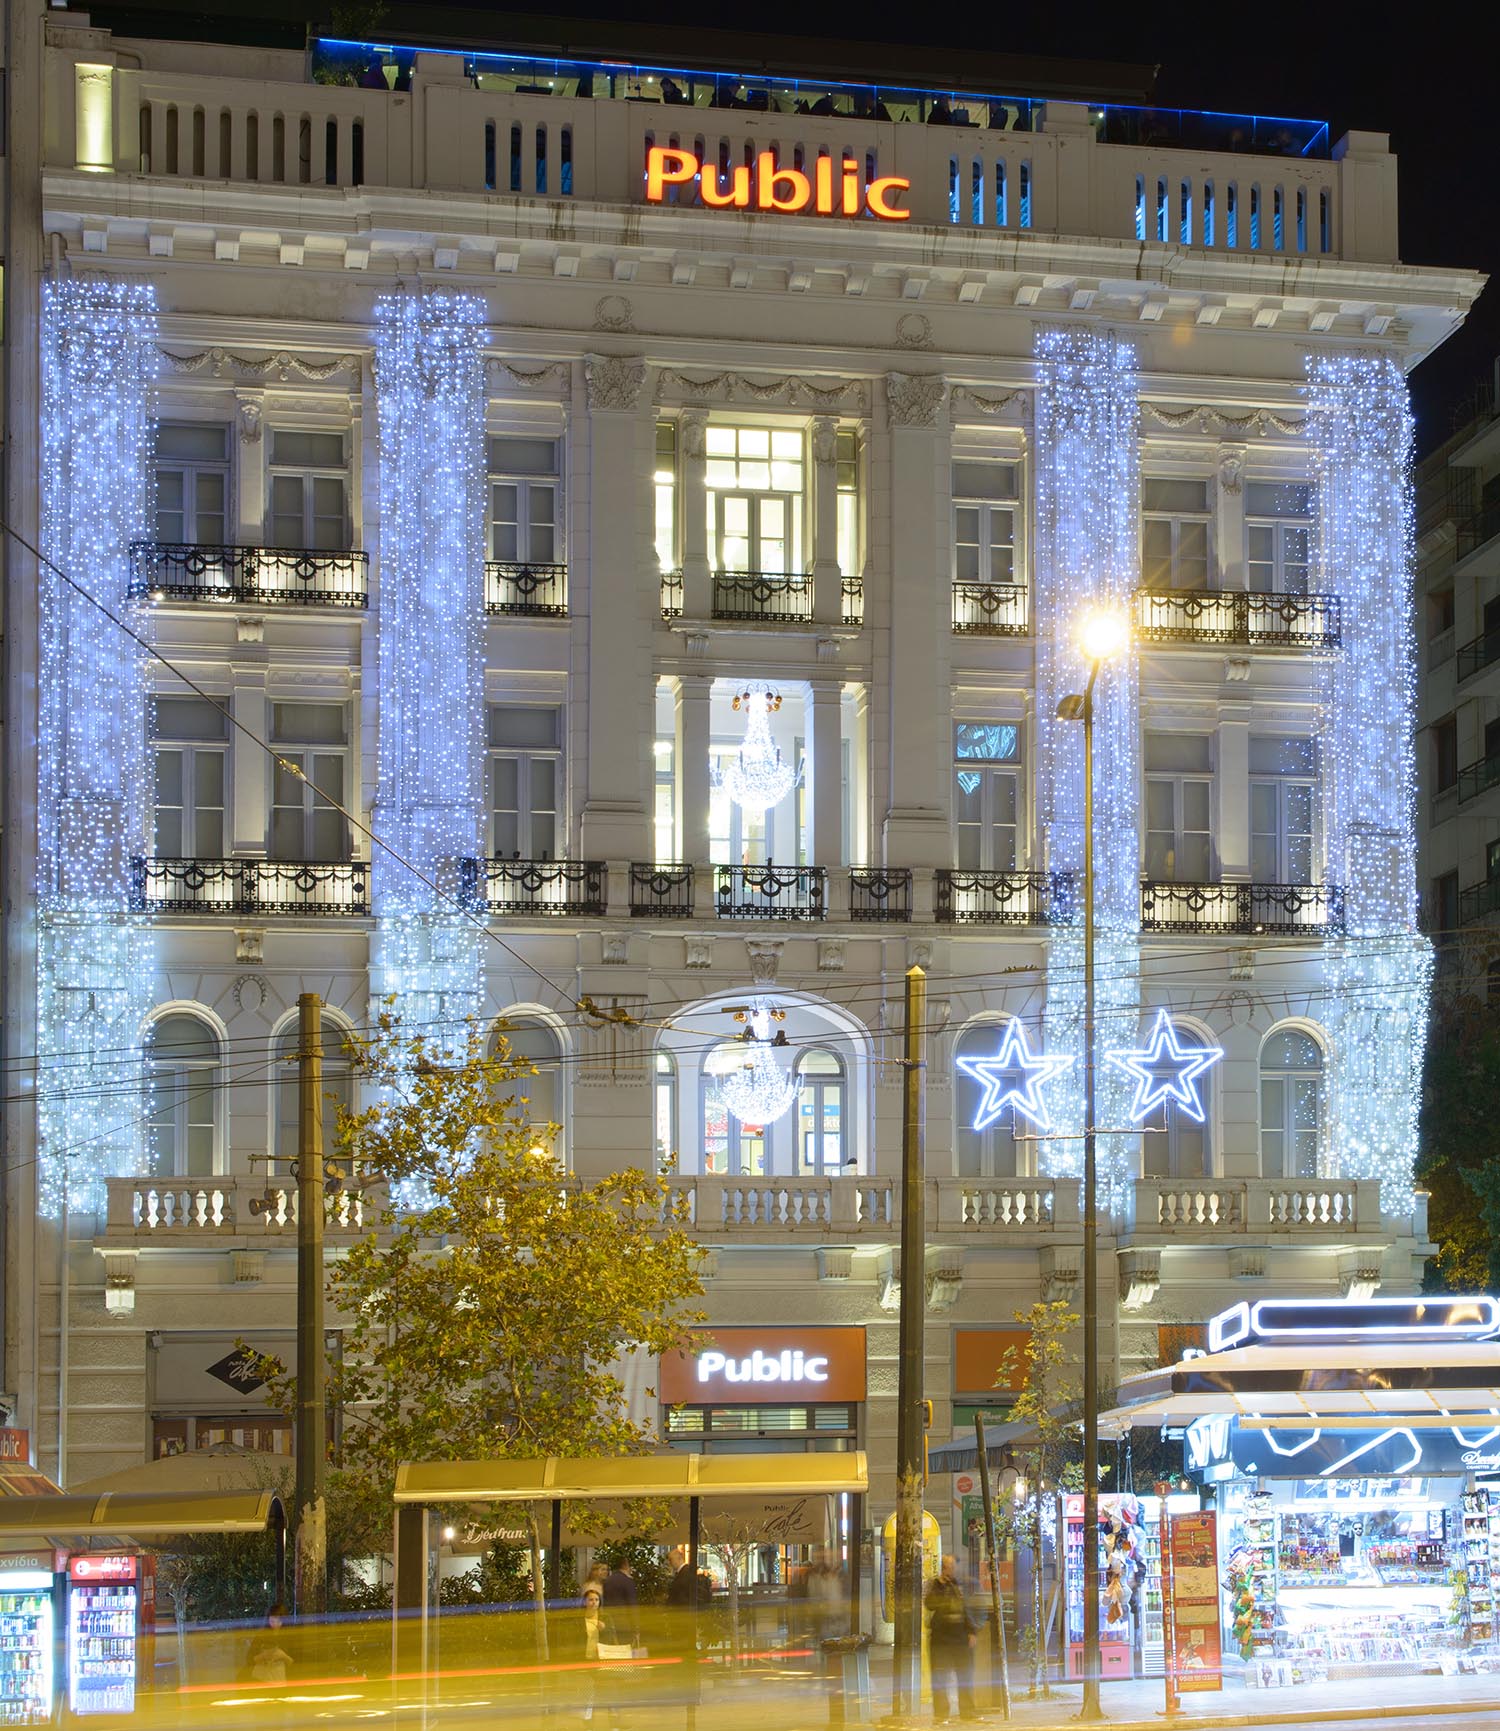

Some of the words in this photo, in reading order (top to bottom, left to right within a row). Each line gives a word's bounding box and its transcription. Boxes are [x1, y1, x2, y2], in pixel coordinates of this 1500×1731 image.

[646, 146, 911, 219] Public
[698, 1350, 828, 1382] Public
[1160, 1485, 1166, 1494] 1
